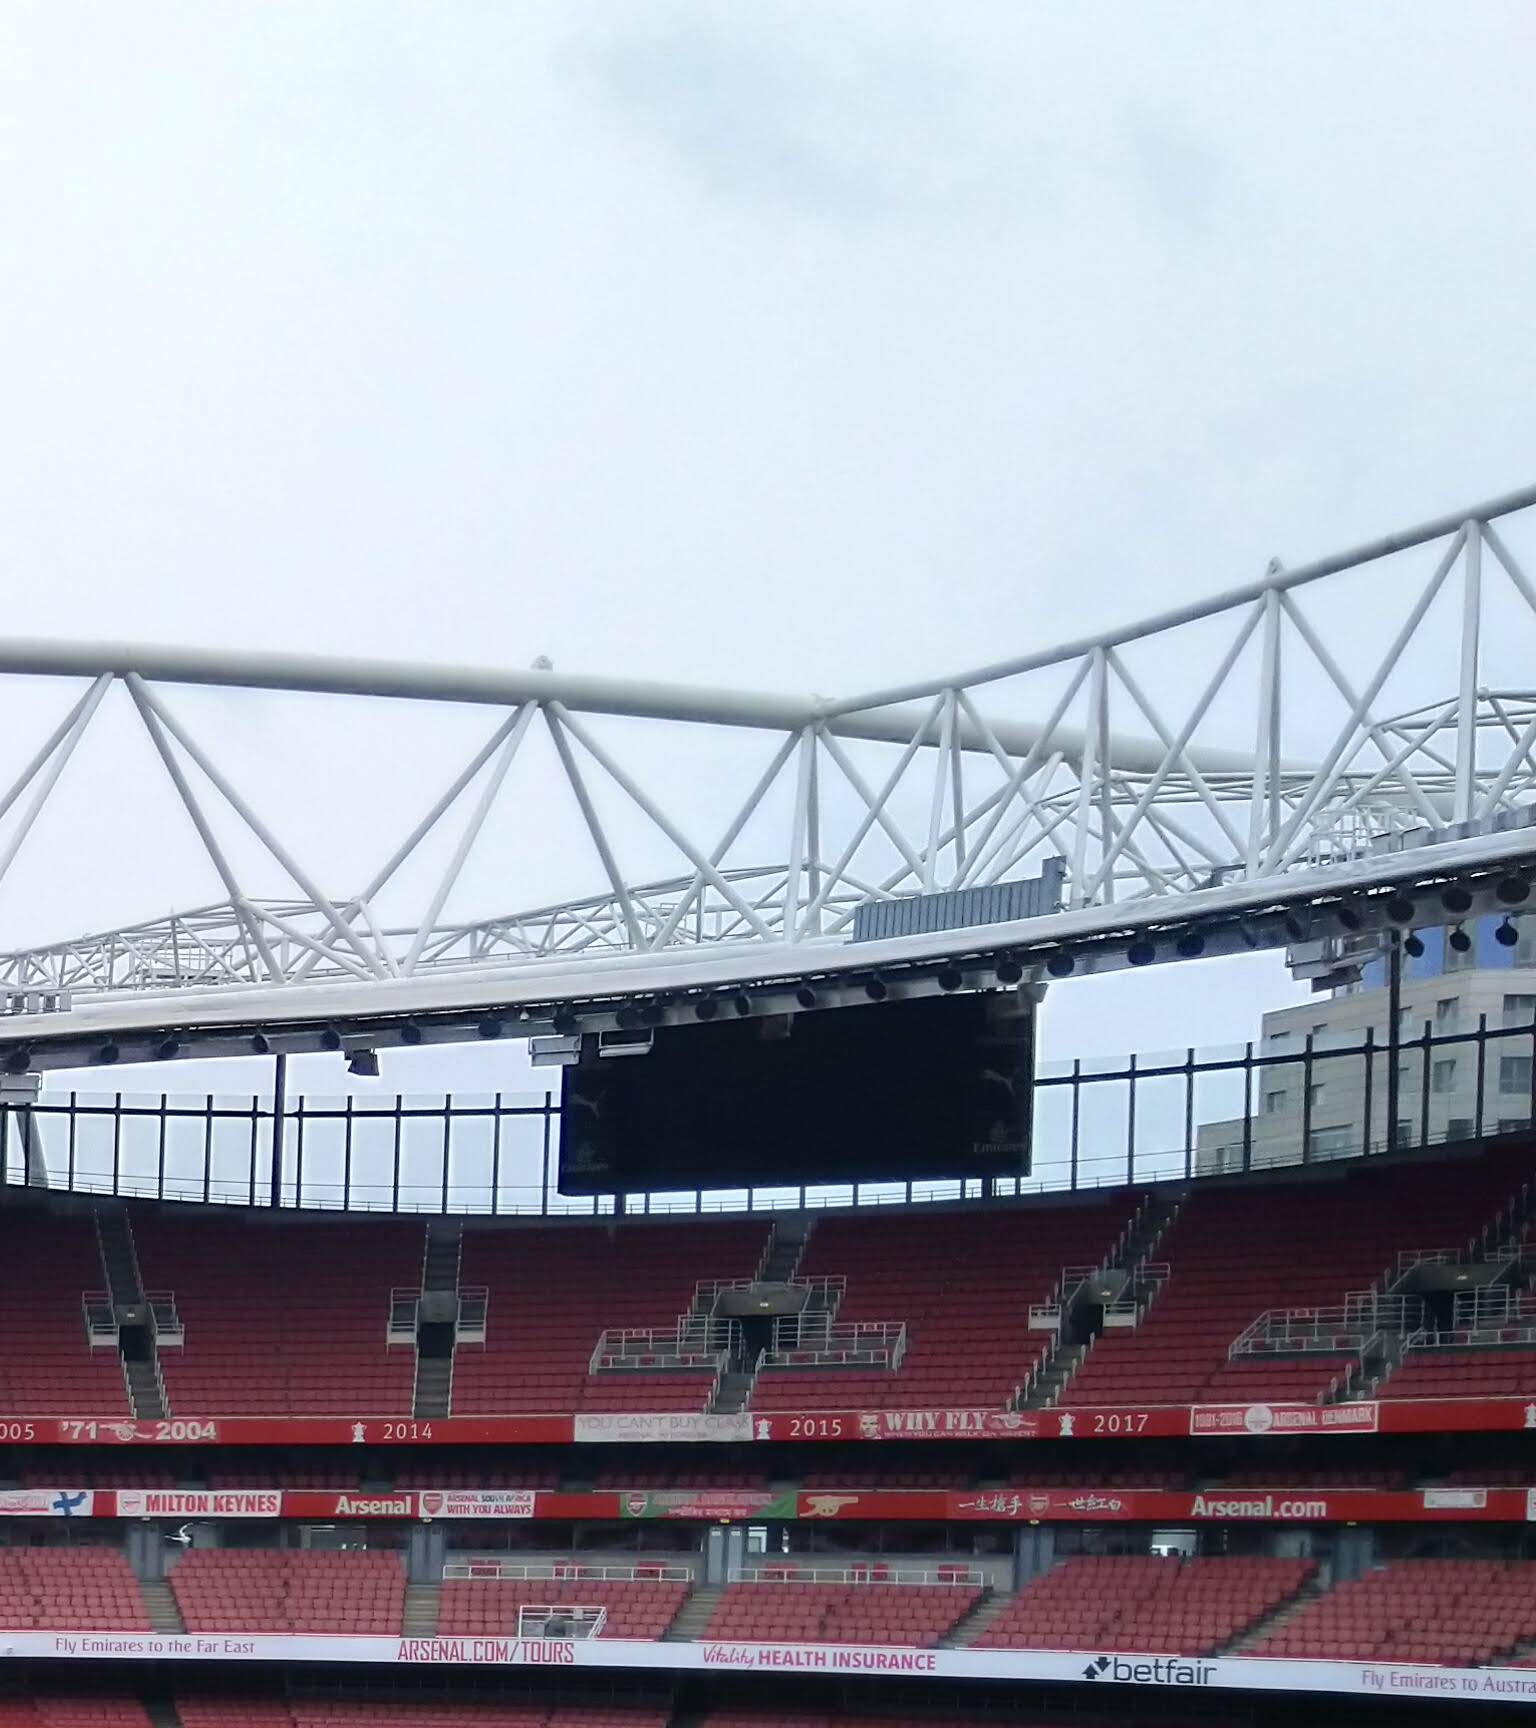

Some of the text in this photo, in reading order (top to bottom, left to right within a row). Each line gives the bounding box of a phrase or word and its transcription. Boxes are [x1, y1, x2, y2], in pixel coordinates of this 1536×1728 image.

[577, 1416, 612, 1429] YOU
[670, 1417, 699, 1429] BUY
[789, 1419, 842, 1437] 2015
[884, 1411, 988, 1430] WHY FLY
[1094, 1414, 1149, 1433] 2017
[155, 1422, 217, 1440] 2004
[382, 1423, 433, 1440] 2014
[146, 1495, 278, 1513] MILTON KEYNES
[334, 1496, 411, 1515] Arsenal
[447, 1494, 479, 1503] ARSENAL
[1191, 1496, 1327, 1517] Arsenal.com
[447, 1504, 531, 1515] WITH YOU ALWAYS
[55, 1638, 256, 1656] Fly Emirates to the Far East
[398, 1640, 575, 1664] ARSENAL.COM/TOURS
[703, 1646, 936, 1671] Vitality HEALTH INSURANCE
[1113, 1654, 1217, 1684] betfair
[1362, 1670, 1384, 1690] Fly
[1391, 1672, 1456, 1690] Emirates
[1462, 1677, 1478, 1691] to
